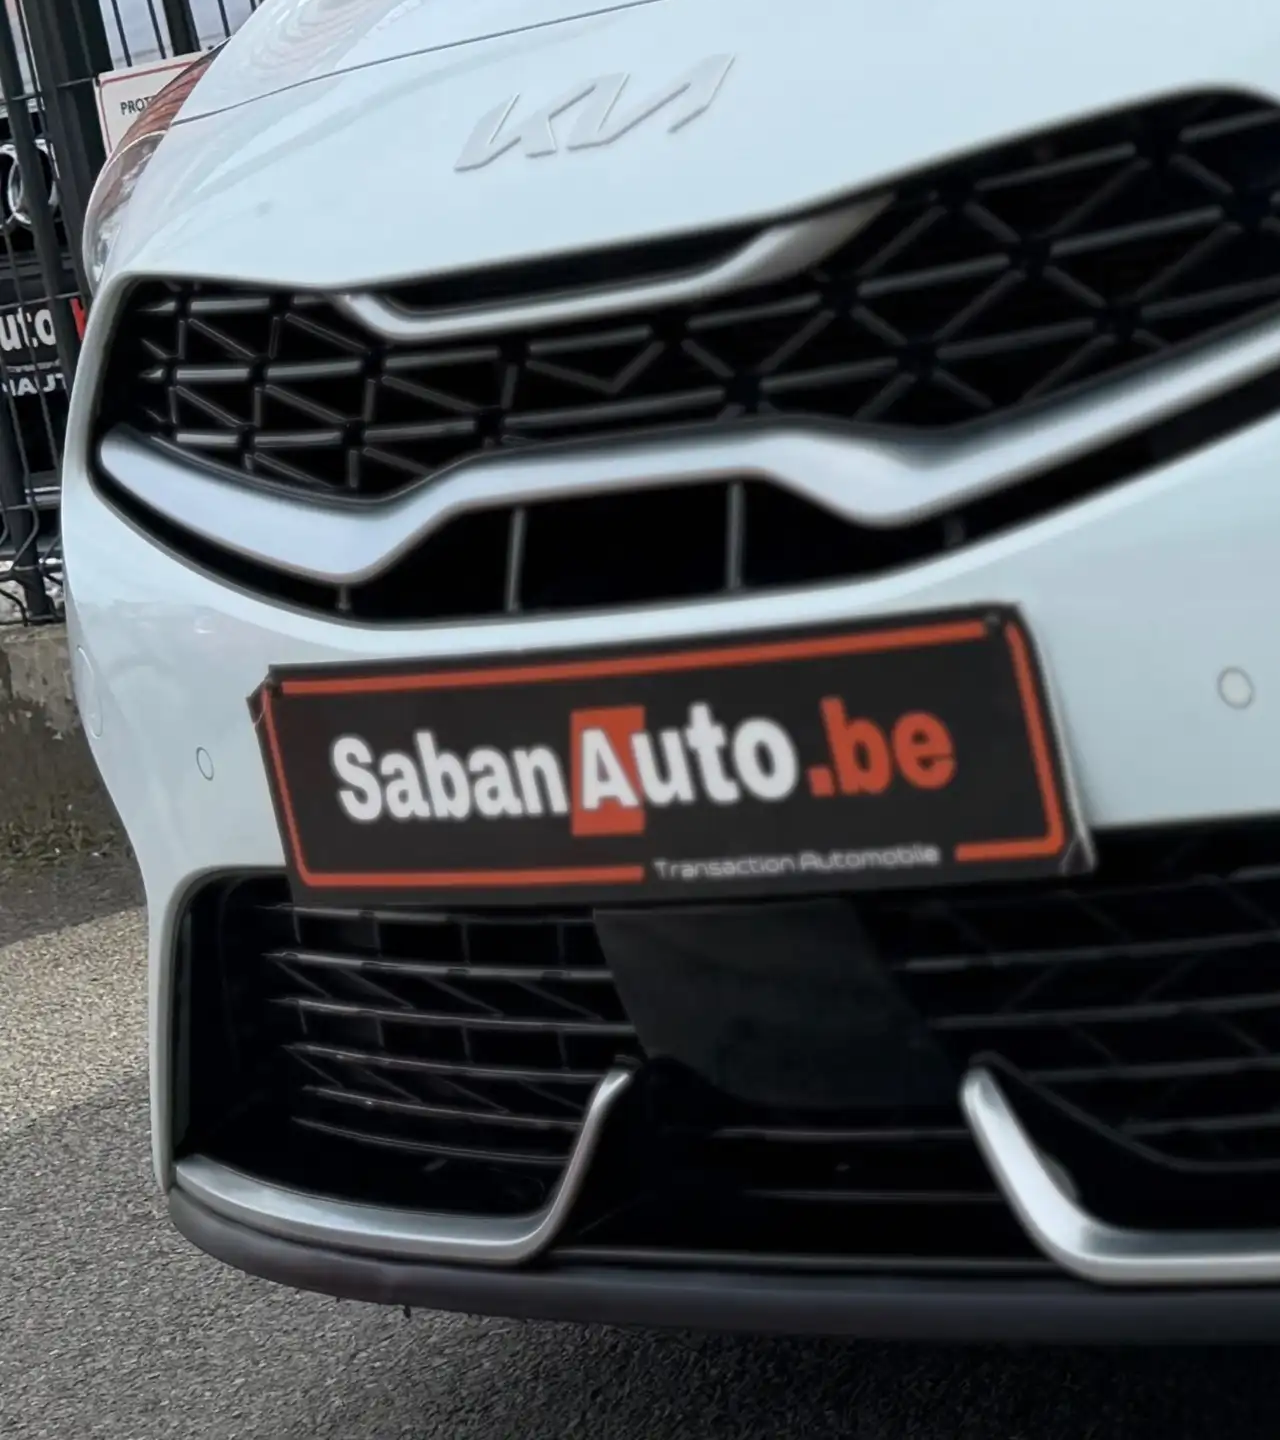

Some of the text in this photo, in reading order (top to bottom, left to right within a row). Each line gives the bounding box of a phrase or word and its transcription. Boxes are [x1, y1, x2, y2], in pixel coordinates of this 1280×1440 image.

[453, 53, 738, 174] KIA
[330, 696, 955, 823] SabanAuto.be
[653, 843, 942, 880] Transaction Automobile
